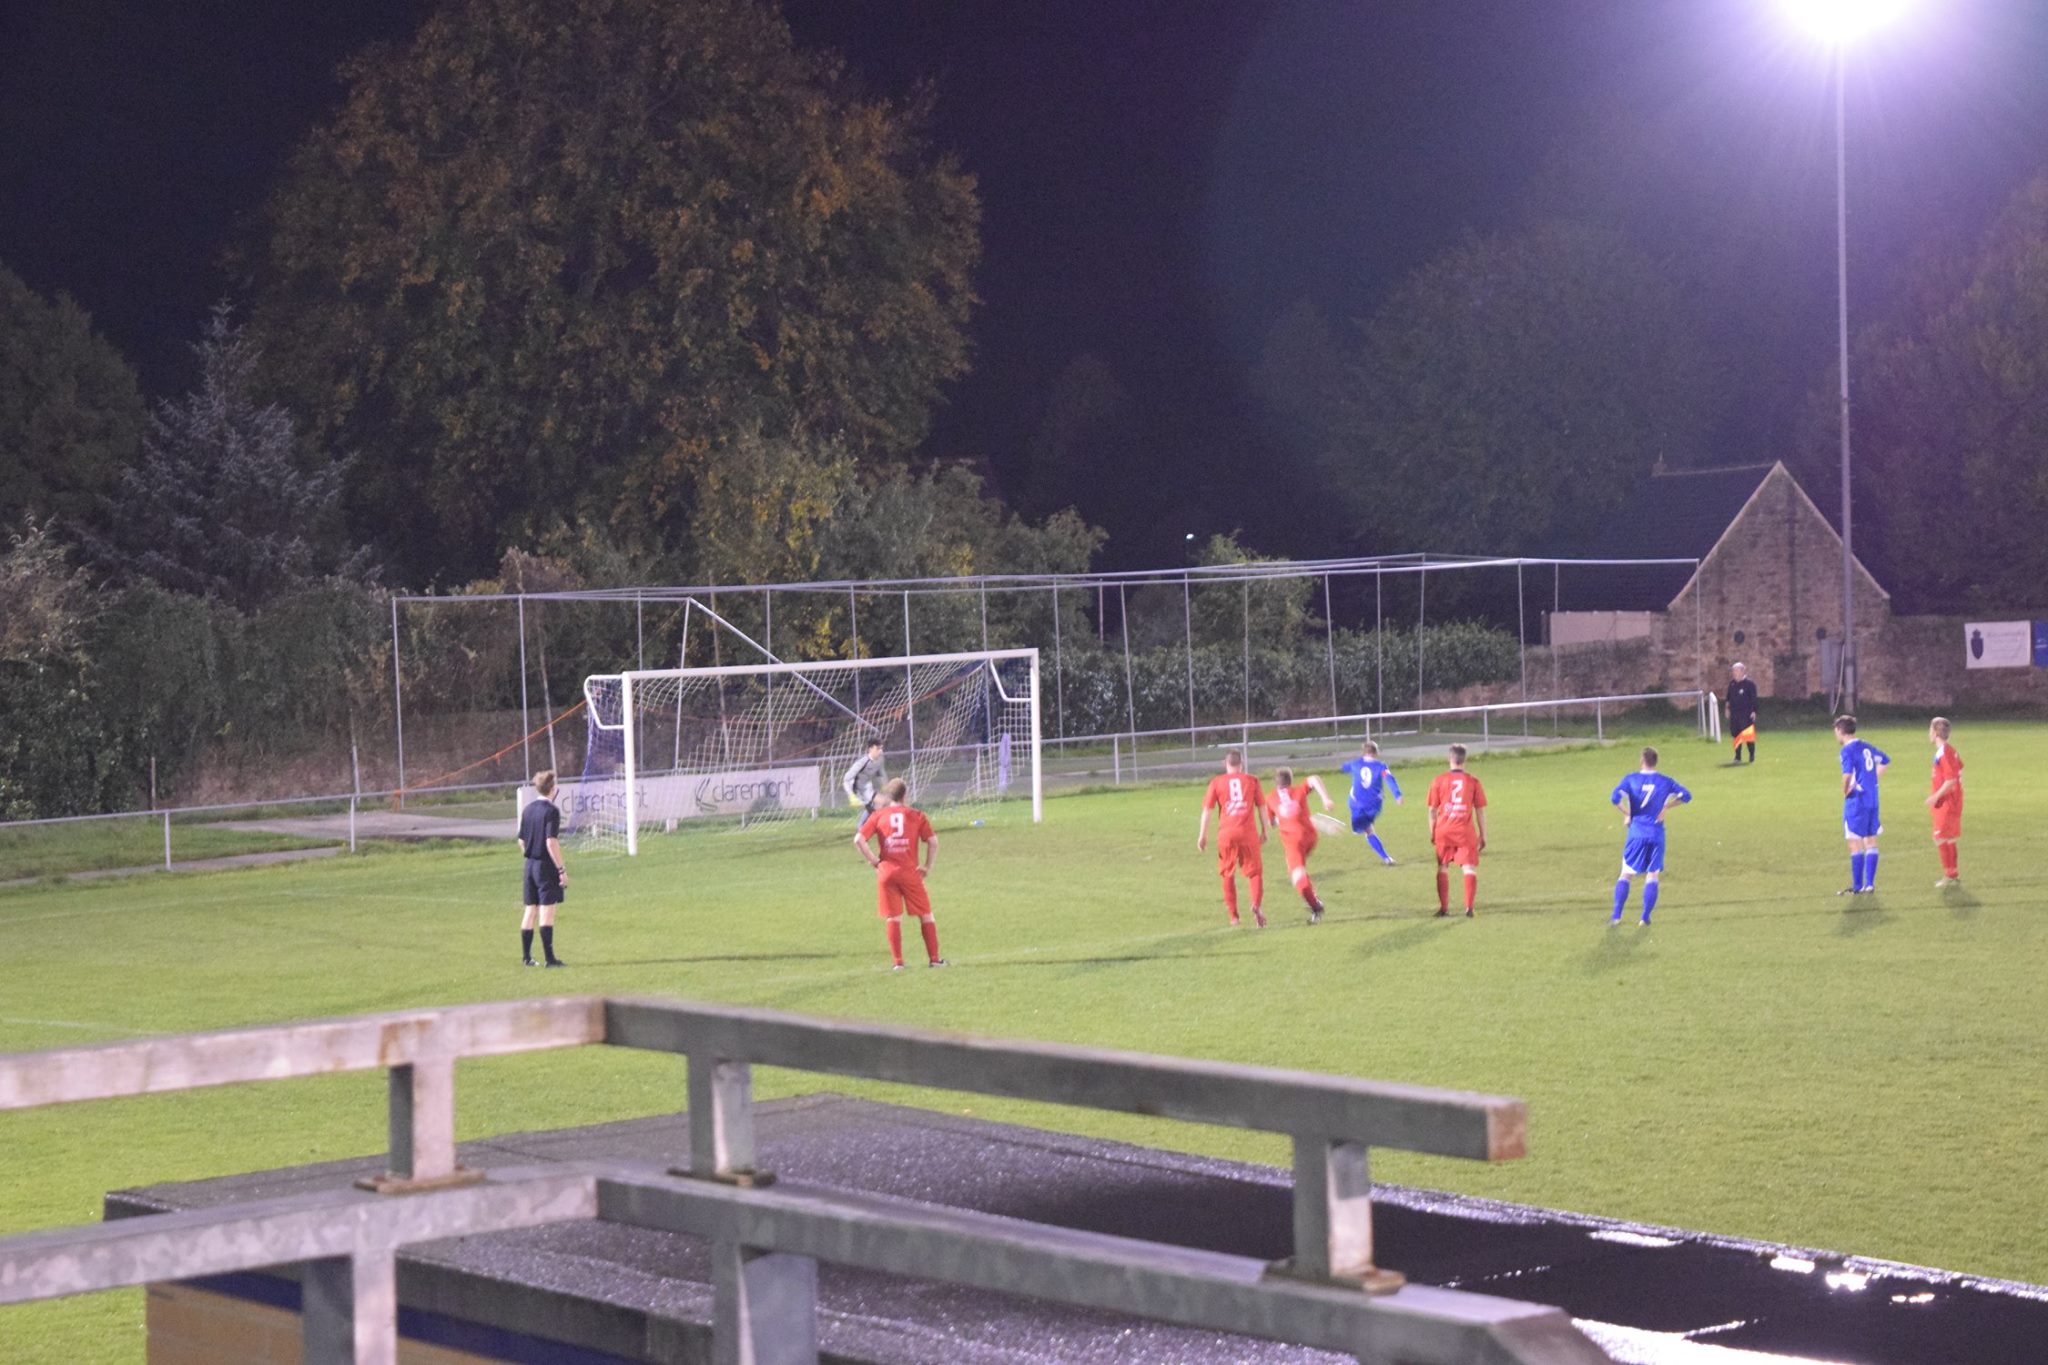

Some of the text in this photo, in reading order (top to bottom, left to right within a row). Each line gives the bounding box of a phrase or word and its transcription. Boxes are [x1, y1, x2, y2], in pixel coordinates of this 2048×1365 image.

[1862, 748, 1874, 772] 8
[712, 775, 794, 803] claremont
[1360, 766, 1372, 789] 9
[1451, 779, 1464, 803] 2
[1640, 783, 1656, 809] 7
[890, 812, 904, 838] 9
